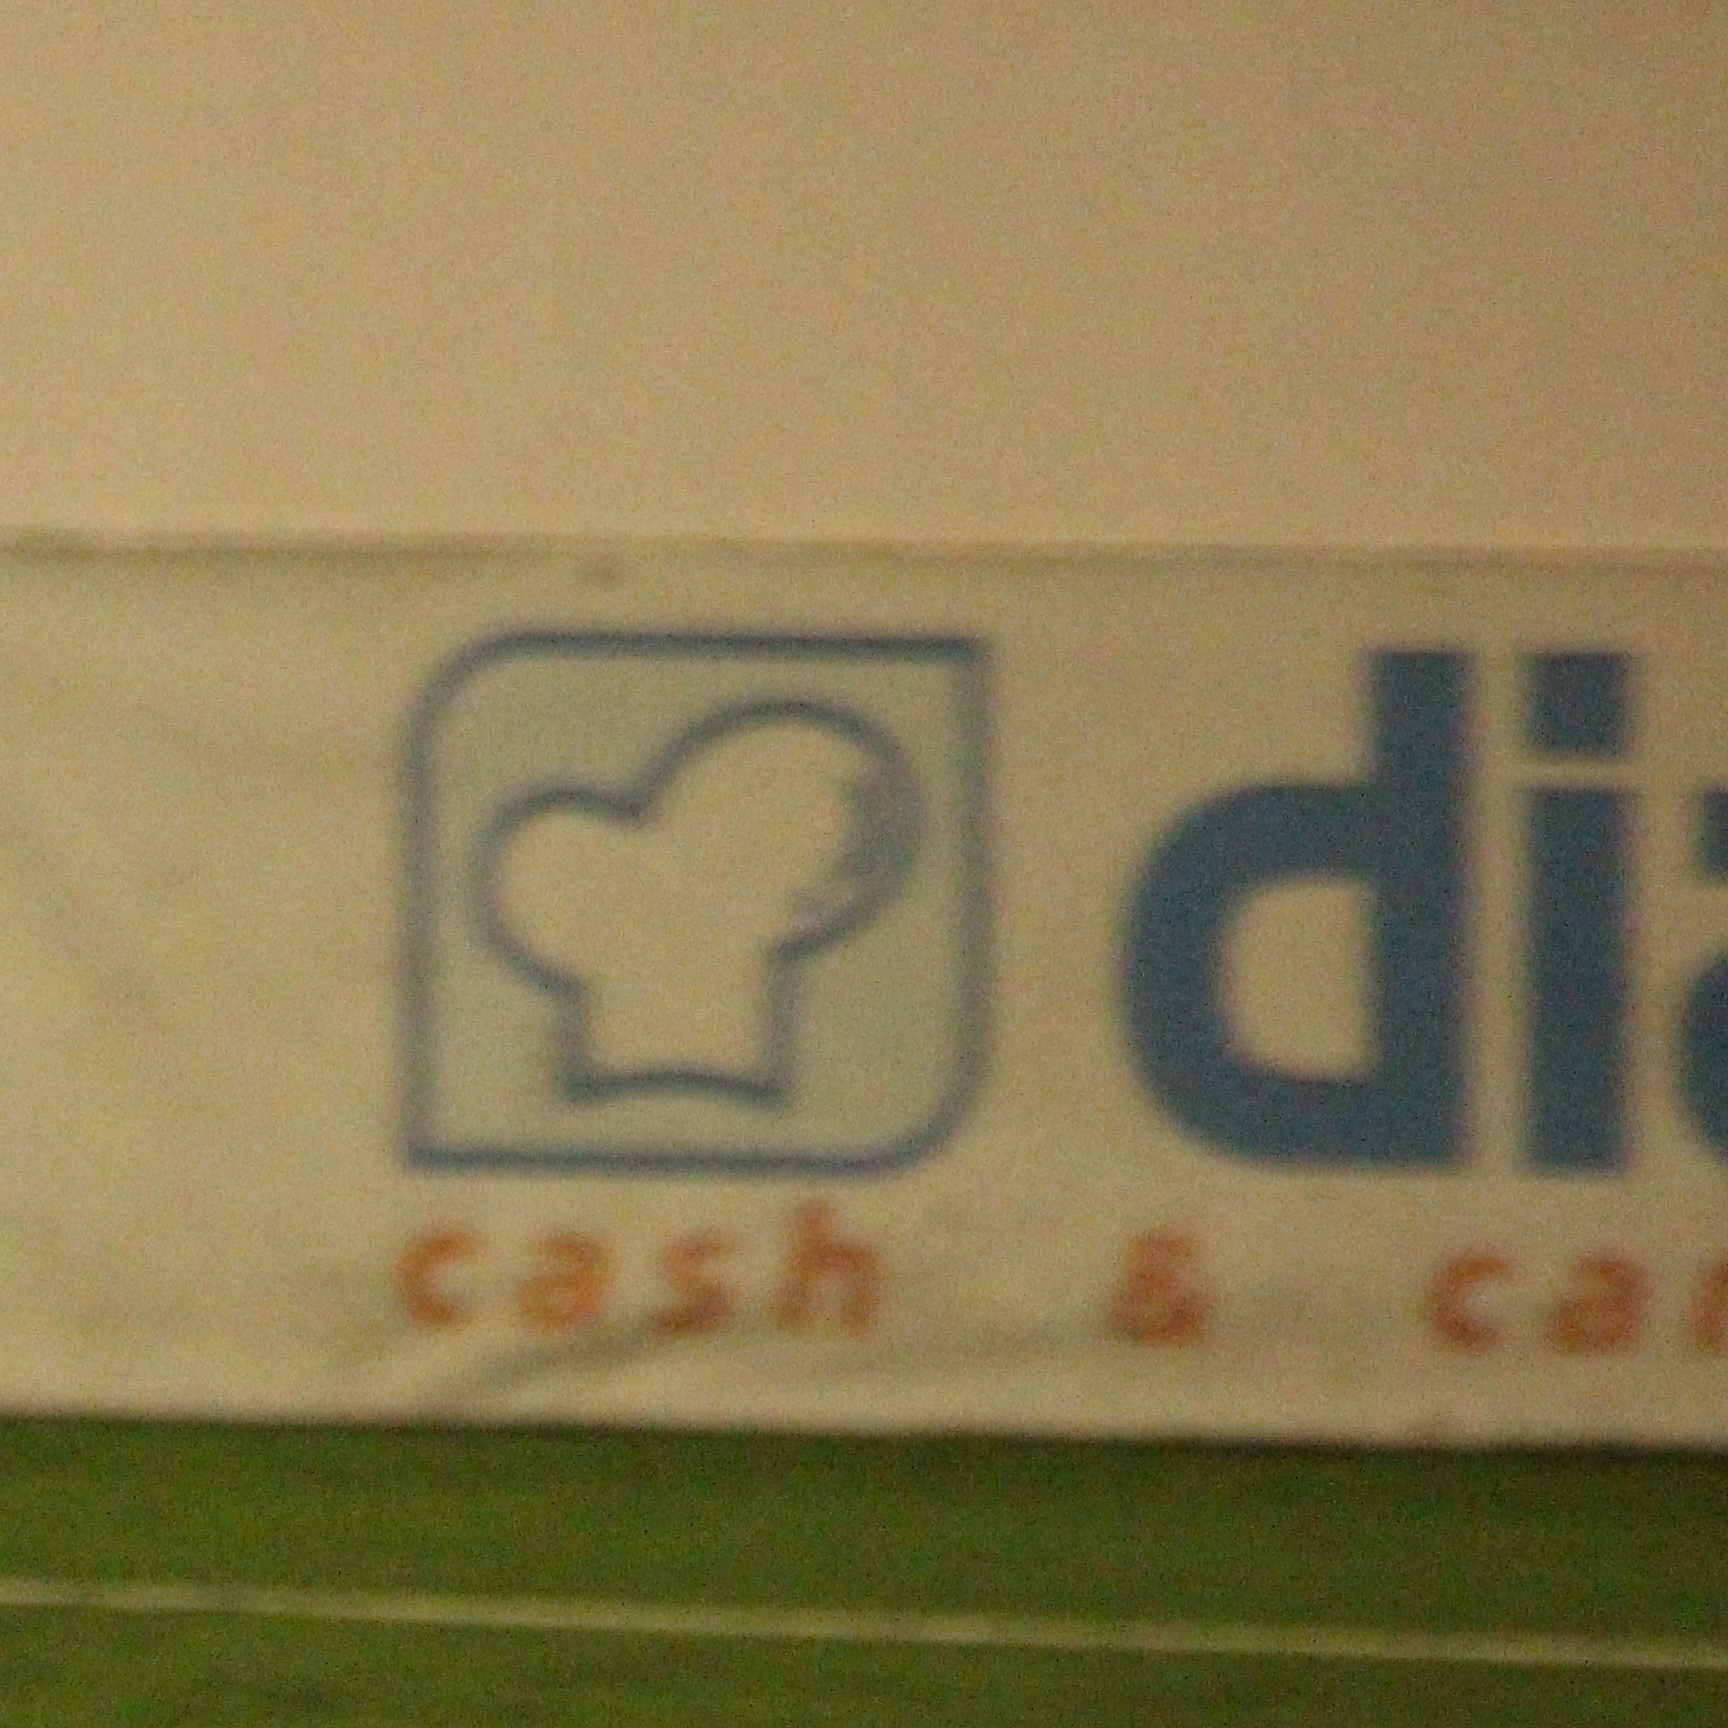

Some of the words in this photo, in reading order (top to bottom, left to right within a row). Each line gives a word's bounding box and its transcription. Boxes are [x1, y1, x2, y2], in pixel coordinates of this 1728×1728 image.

[1112, 645, 1728, 1176] di
[394, 1195, 886, 1345] cash
[1107, 1222, 1224, 1350] &
